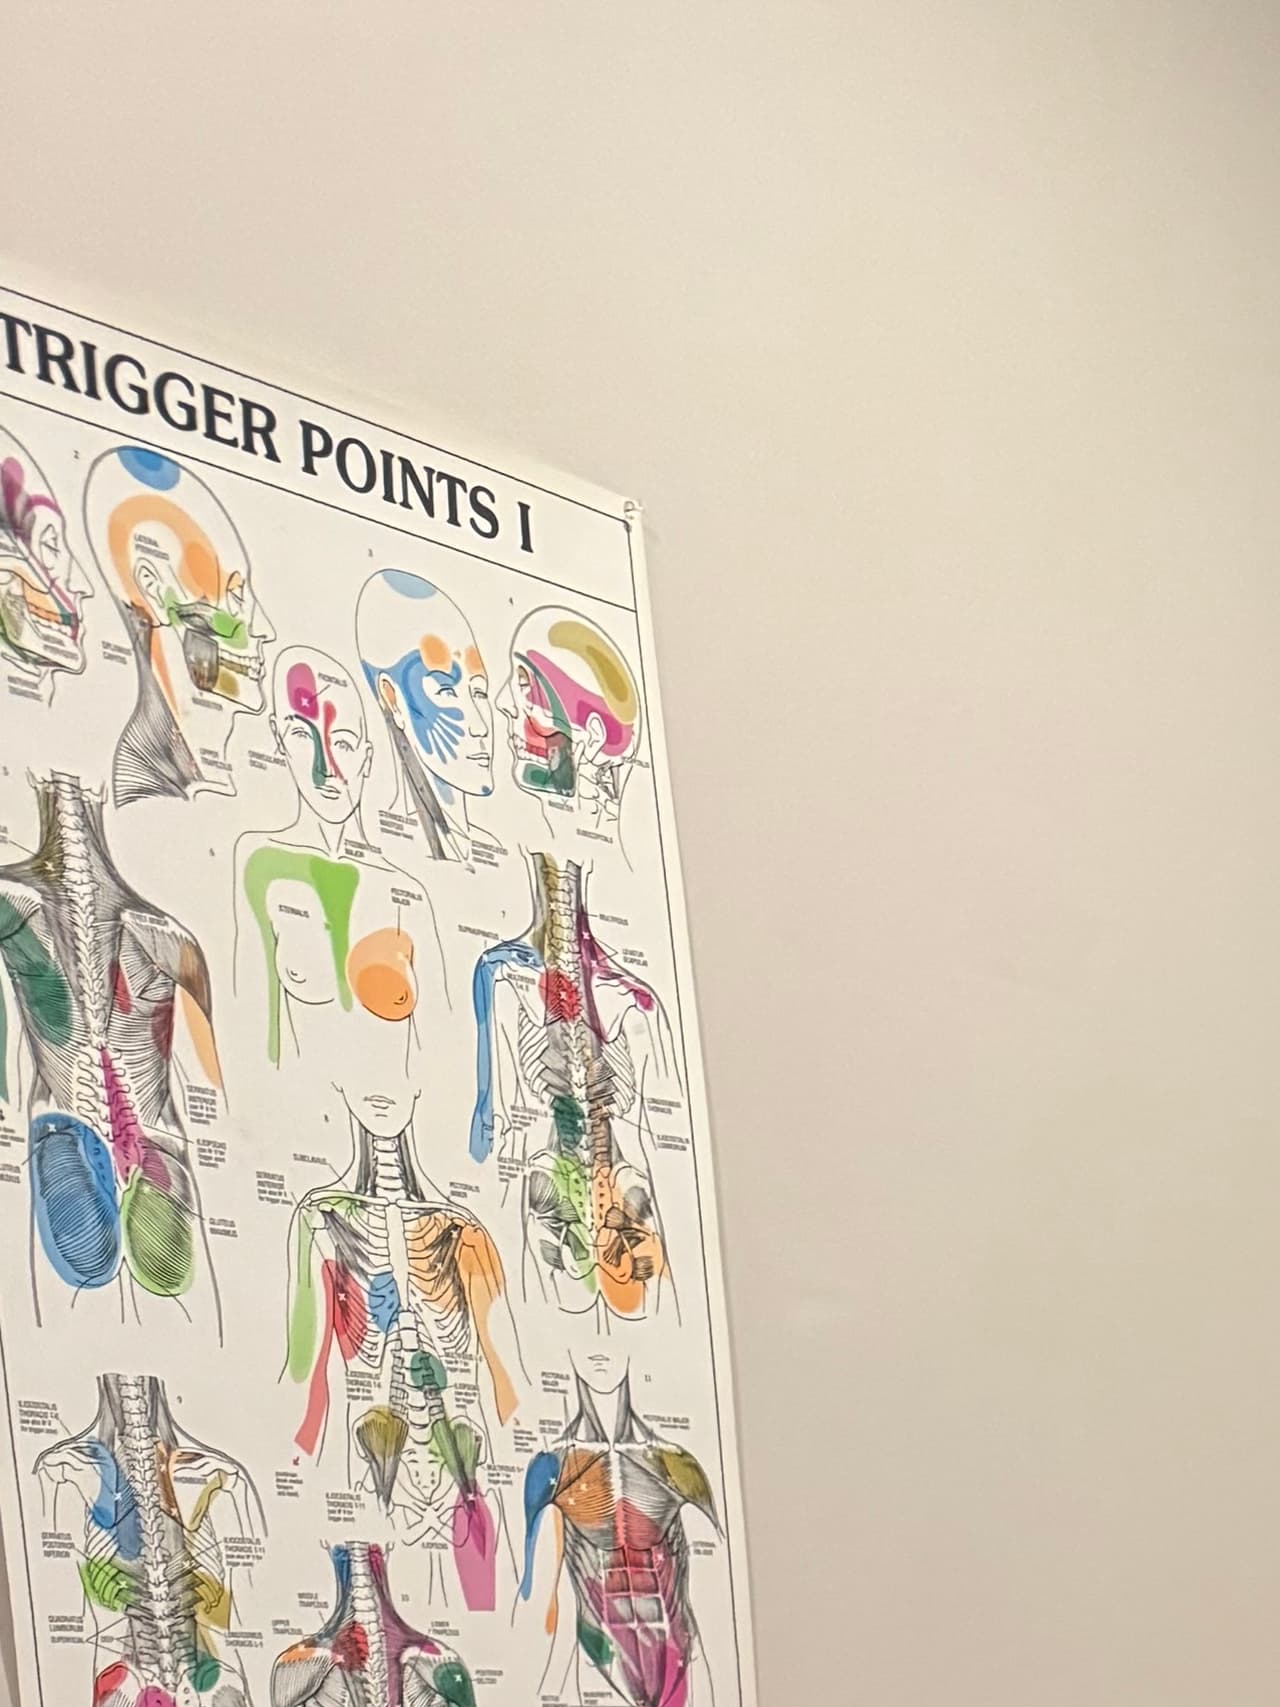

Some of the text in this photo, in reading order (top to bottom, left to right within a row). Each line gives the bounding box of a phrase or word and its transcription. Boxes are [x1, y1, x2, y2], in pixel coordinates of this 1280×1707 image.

[0, 311, 535, 554] TRIGGER POINTS I
